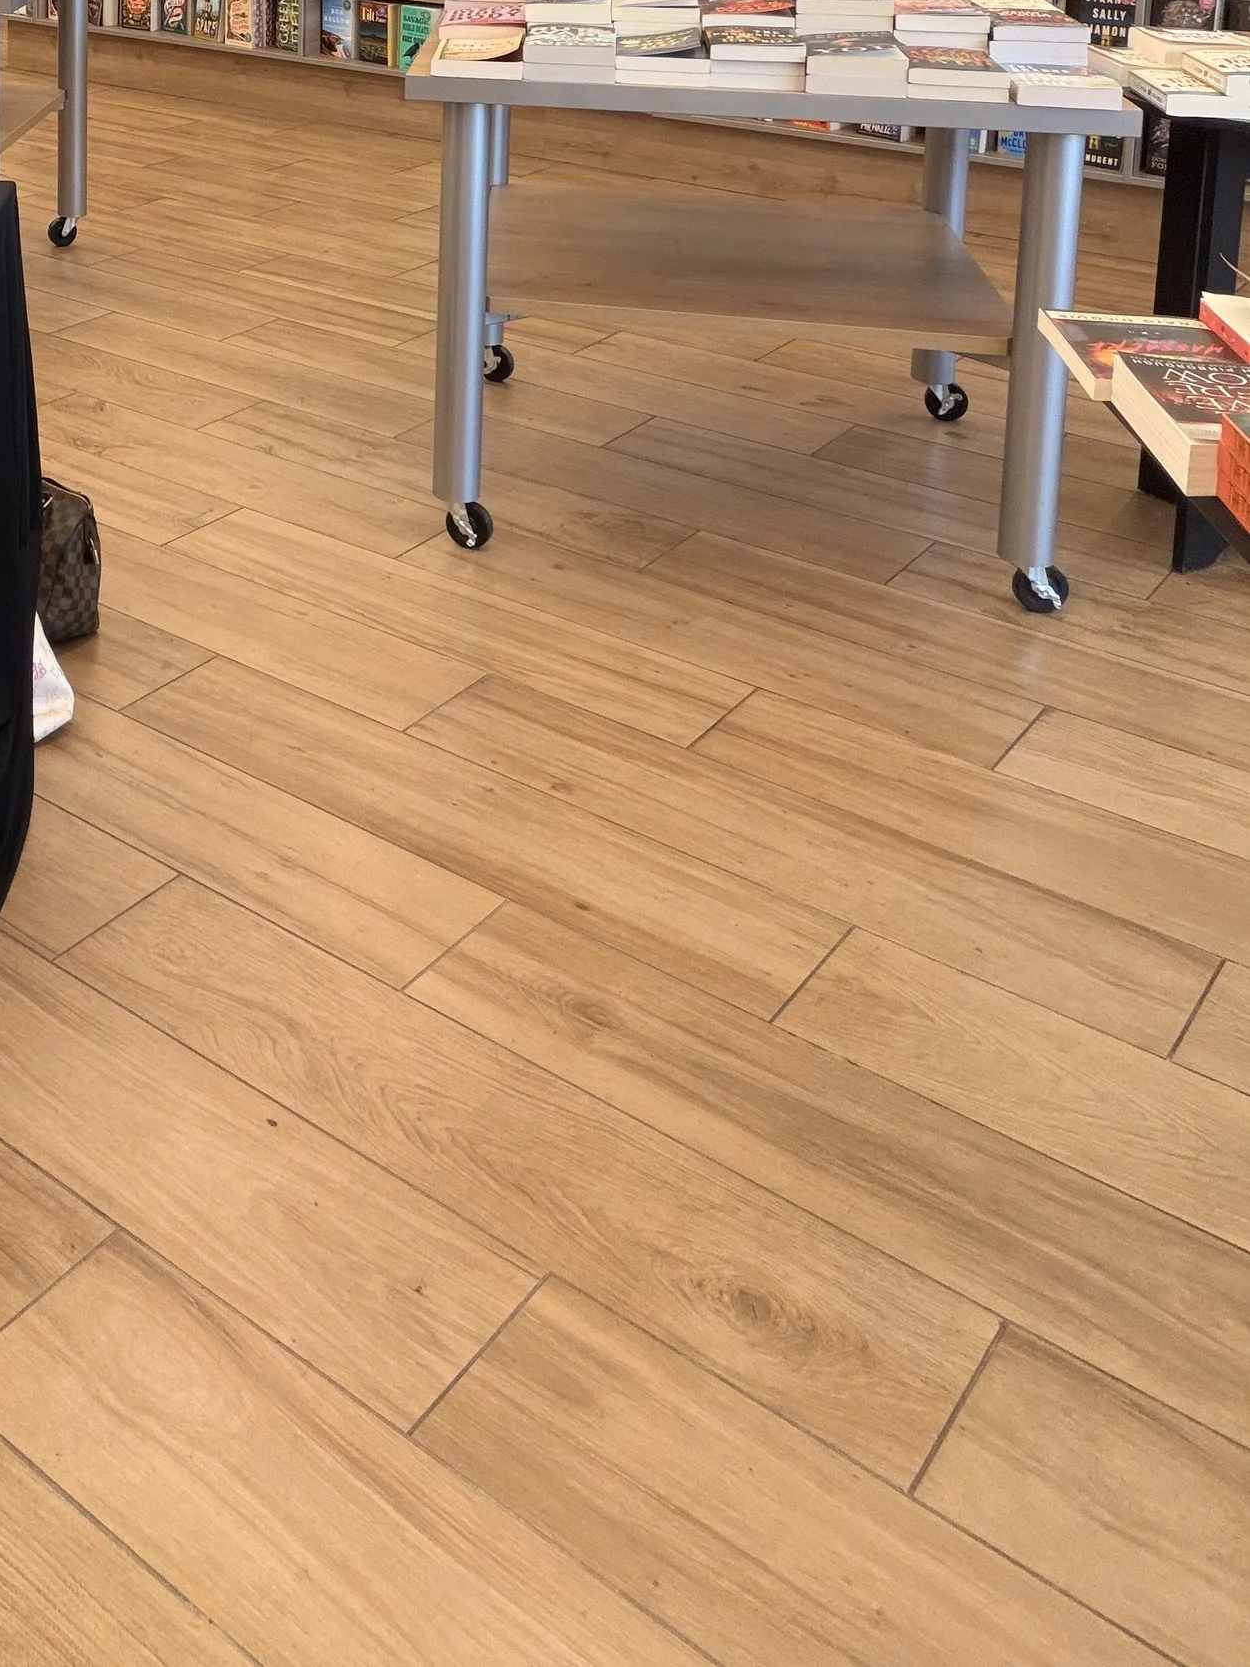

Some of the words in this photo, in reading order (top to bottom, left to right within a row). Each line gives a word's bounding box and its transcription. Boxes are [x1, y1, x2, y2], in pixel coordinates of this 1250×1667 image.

[361, 7, 375, 21] Tilt
[1092, 8, 1127, 21] SALLY
[1132, 357, 1235, 372] PINBOROUGH
